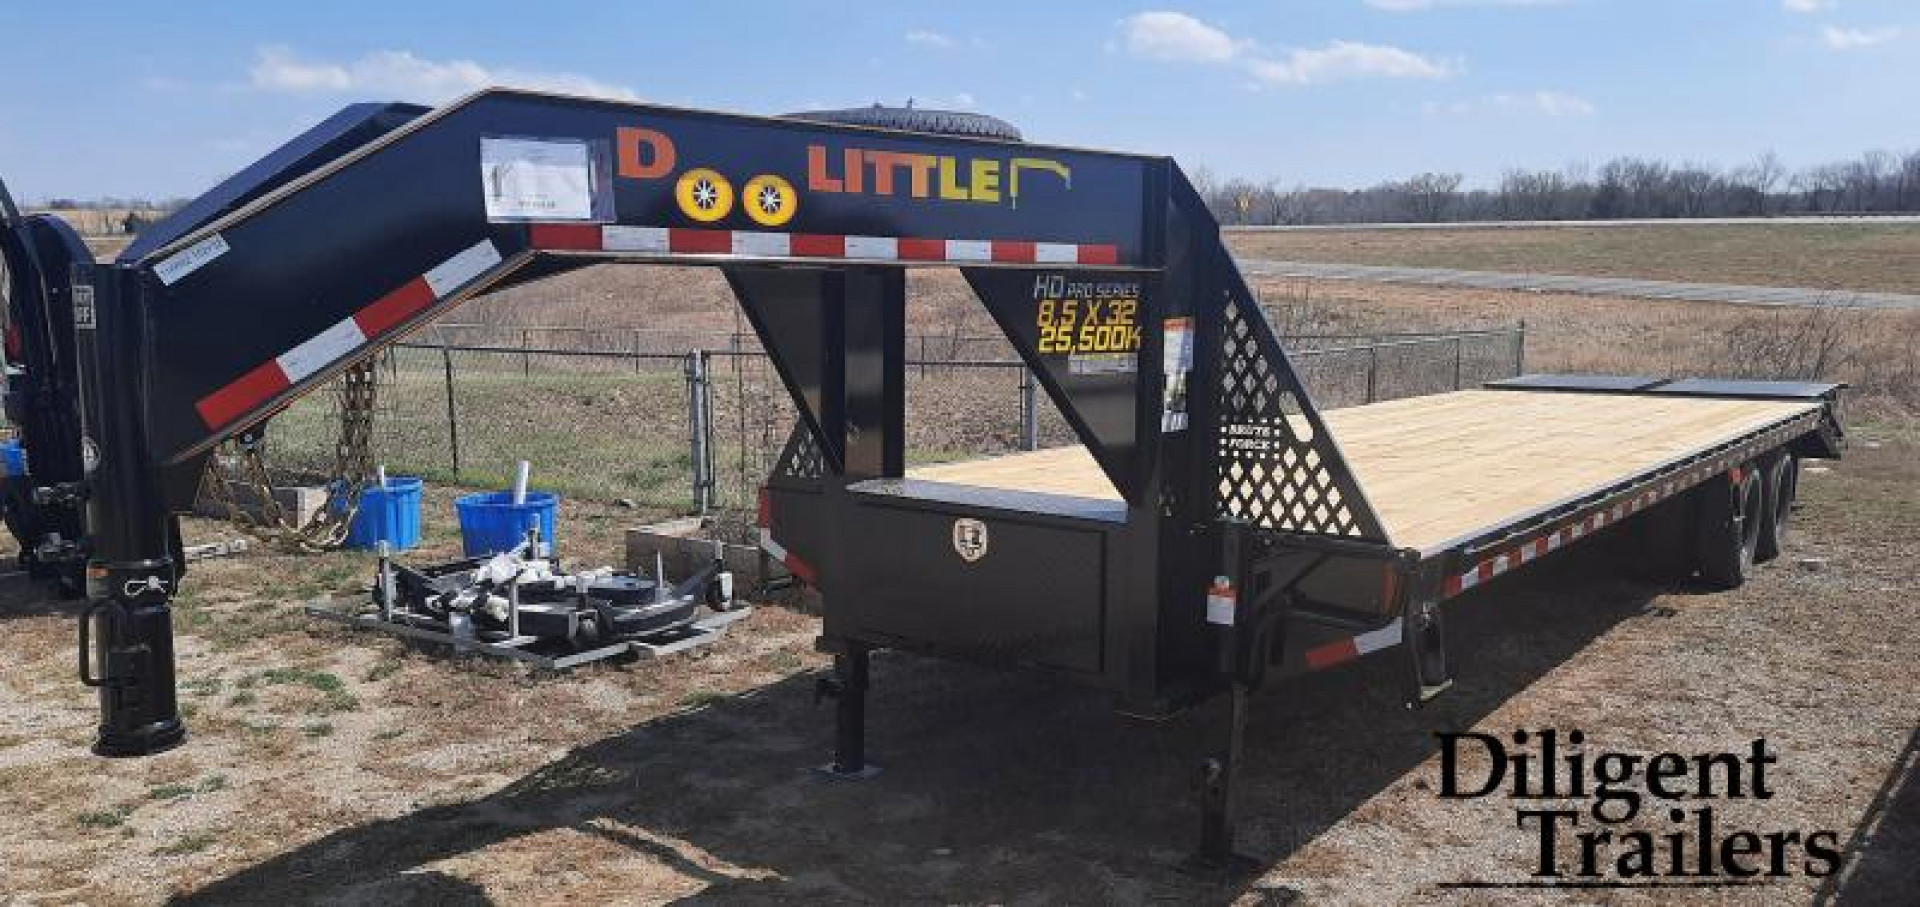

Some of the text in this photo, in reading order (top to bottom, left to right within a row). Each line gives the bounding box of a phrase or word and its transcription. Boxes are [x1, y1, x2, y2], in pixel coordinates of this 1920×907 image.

[1034, 275, 1139, 298] HD PRO SERIES
[1037, 300, 1078, 327] 8.5
[1106, 300, 1136, 325] 32
[1038, 326, 1142, 356] 25,500K
